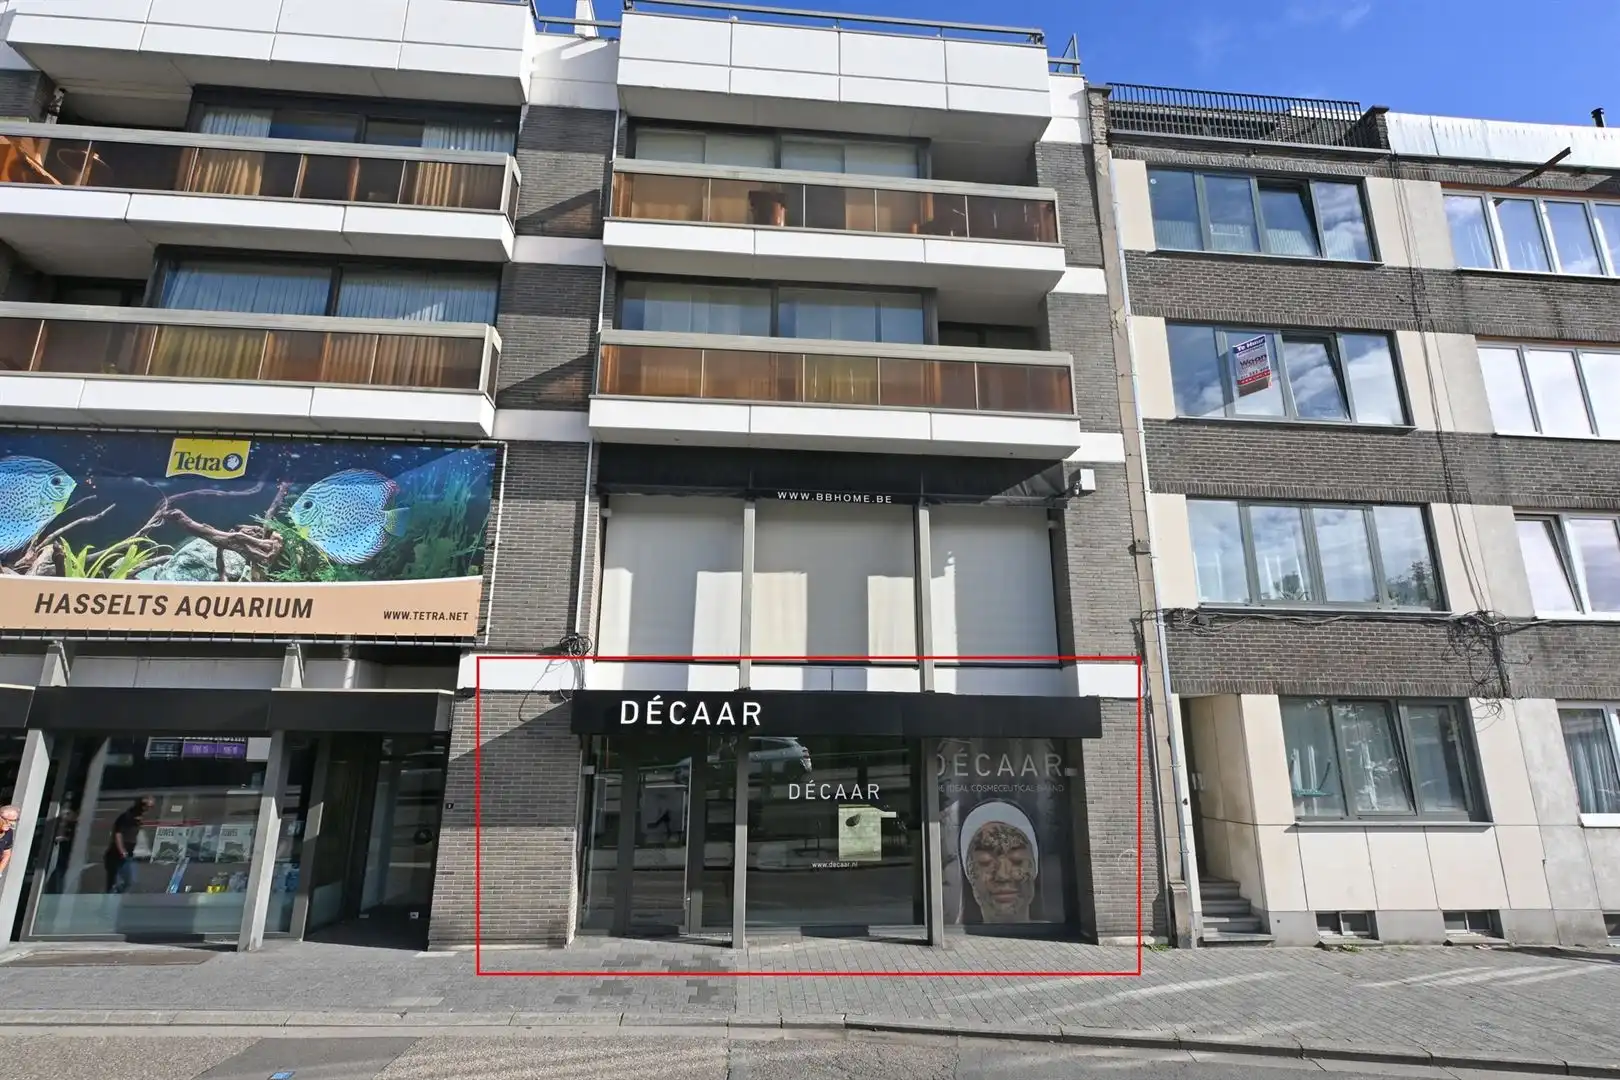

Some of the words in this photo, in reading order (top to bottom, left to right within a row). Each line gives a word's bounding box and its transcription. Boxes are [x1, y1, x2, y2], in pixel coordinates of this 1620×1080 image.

[174, 451, 221, 471] Tetra
[777, 491, 892, 503] WWW.BBHOME.BE
[34, 593, 168, 615] HASSELTS
[174, 595, 314, 619] AQUARIUM
[383, 610, 469, 621] WWW.TETRA.NET
[620, 694, 761, 726] DÉCAAR
[788, 780, 880, 800] DÉCAAR
